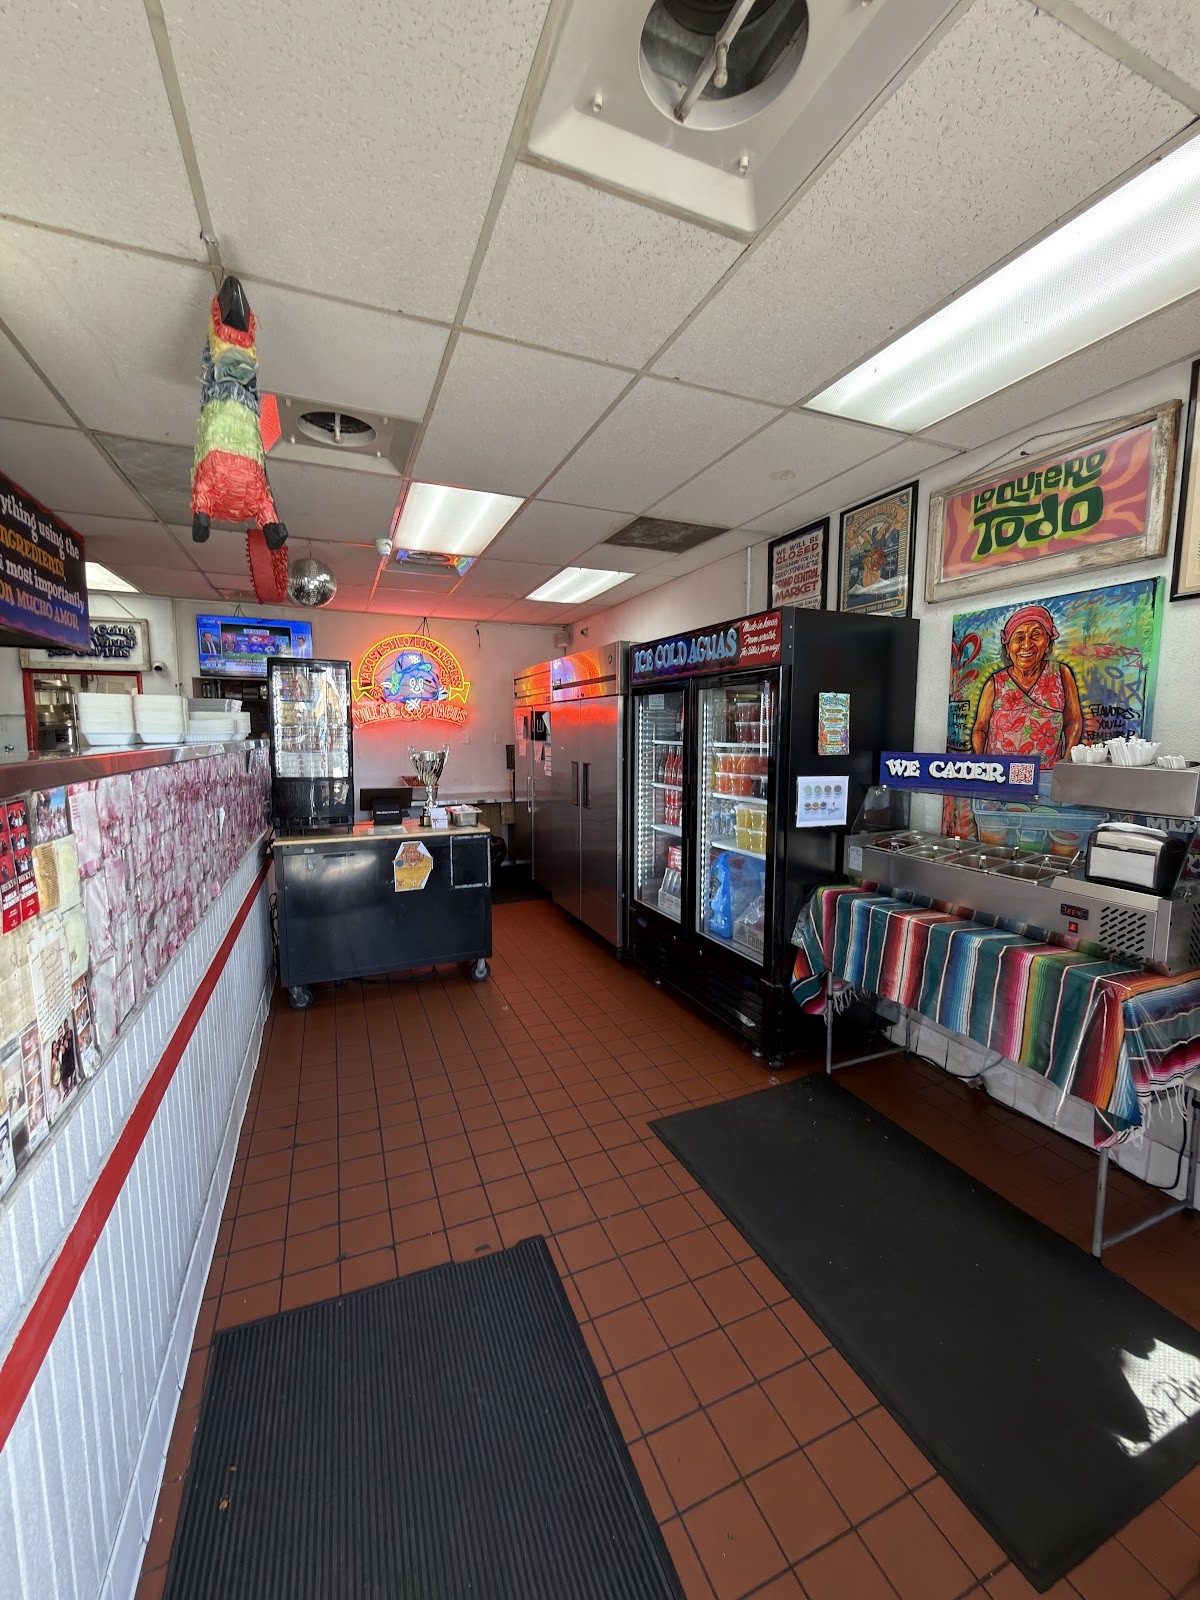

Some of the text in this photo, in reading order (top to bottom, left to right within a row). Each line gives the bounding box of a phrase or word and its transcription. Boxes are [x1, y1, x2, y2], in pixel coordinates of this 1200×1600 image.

[38, 521, 65, 560] using
[65, 537, 80, 560] the
[776, 535, 819, 556] WE WILL BE
[776, 543, 819, 565] CLOSED
[810, 552, 820, 560] OUR
[5, 559, 33, 586] most
[33, 569, 85, 615] importantly
[776, 568, 819, 588] GRAND CENTRAL
[775, 580, 819, 602] MARKET
[16, 587, 53, 619] MUCHO
[360, 636, 461, 687] TACOS ESTILO LOS ANGELES
[634, 628, 737, 673] ICE COLD AGUAS
[353, 701, 468, 723] VILLA'S TACOS
[952, 713, 968, 721] THAT
[1096, 718, 1125, 731] YOU'LL
[885, 758, 1006, 784] WE CATER
